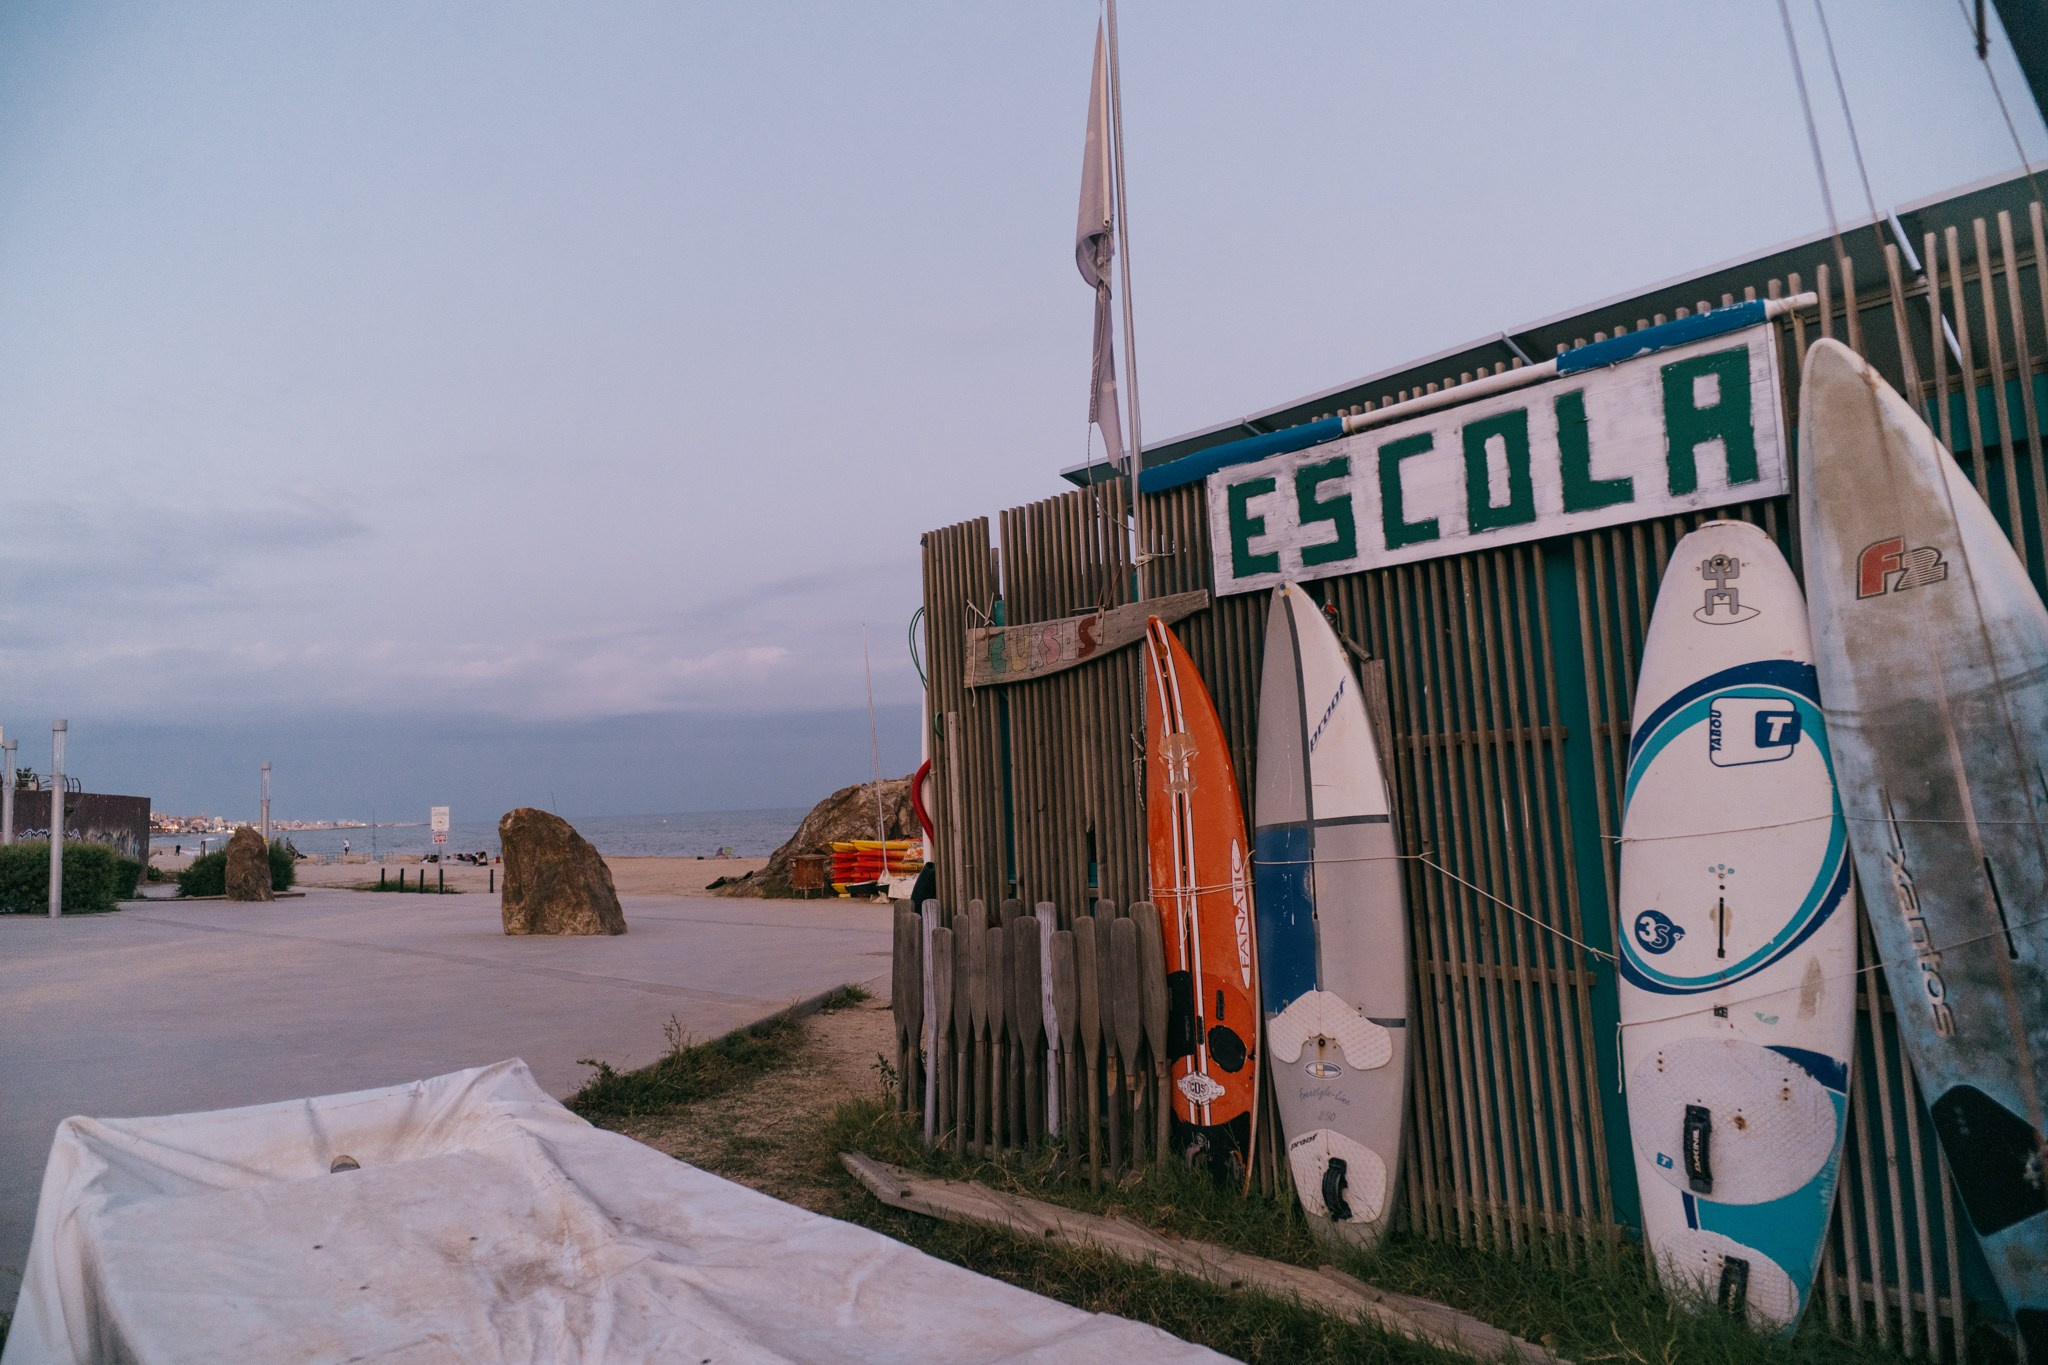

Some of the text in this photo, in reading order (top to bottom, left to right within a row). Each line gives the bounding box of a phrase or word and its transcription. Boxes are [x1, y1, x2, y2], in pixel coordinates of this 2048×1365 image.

[1228, 346, 1759, 579] ESCOLA
[1857, 536, 1948, 600] F2
[991, 616, 1096, 673] CURSOS
[1309, 676, 1345, 753] proof
[1710, 710, 1722, 751] TABOU
[1232, 858, 1250, 969] FANATIC
[1190, 1081, 1207, 1095] CDS
[1291, 1133, 1317, 1151] proof
[1692, 1129, 1701, 1173] DAKINE
